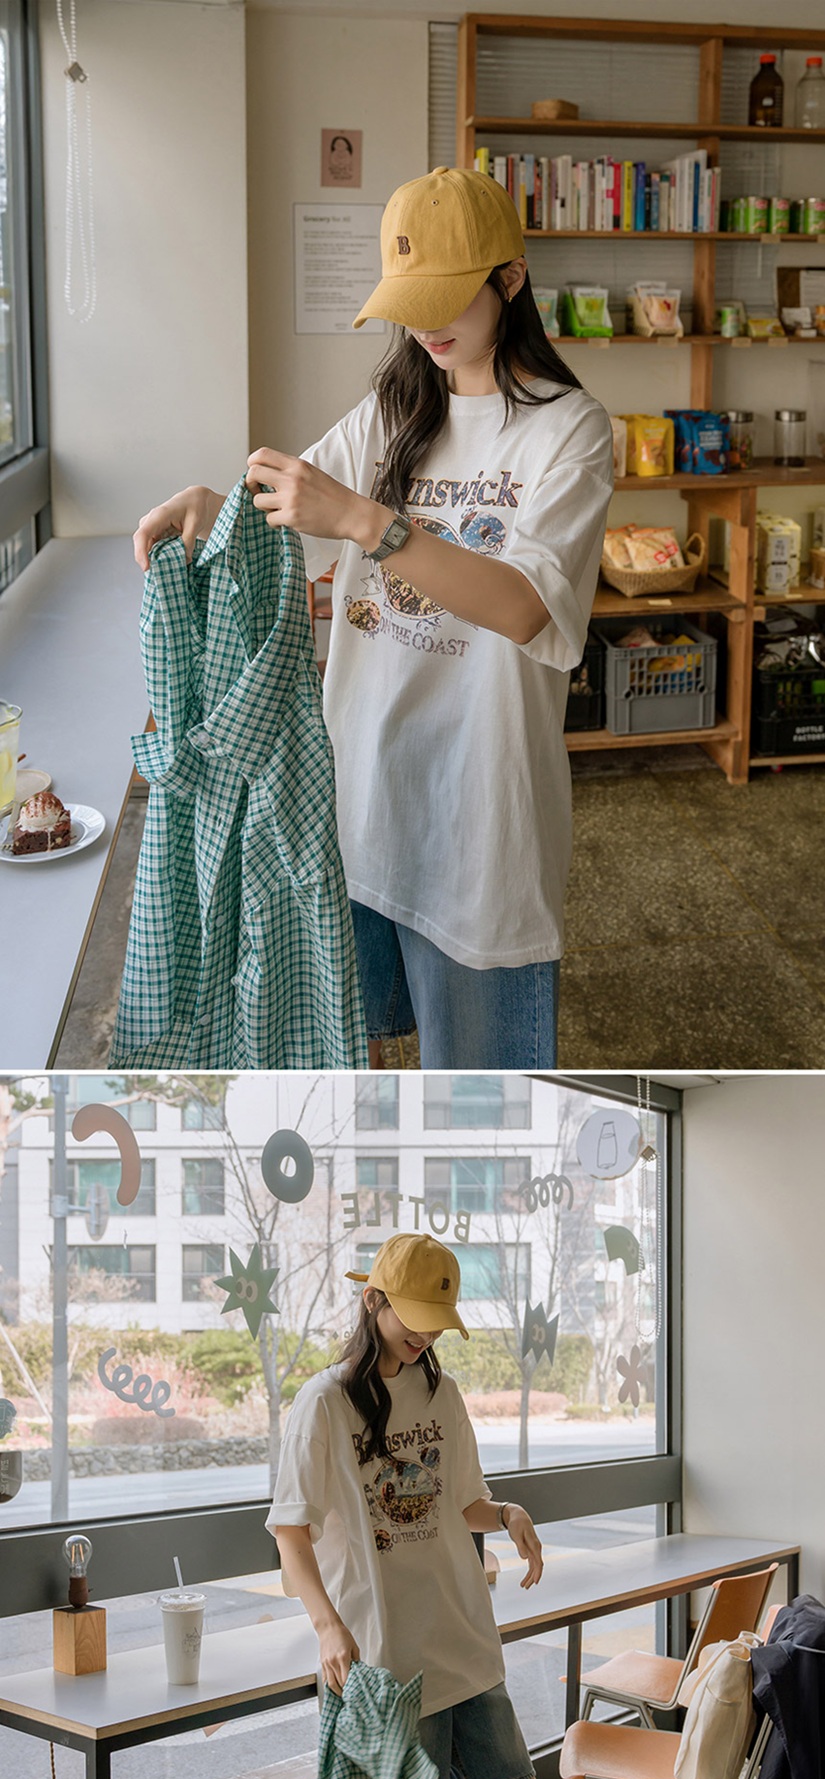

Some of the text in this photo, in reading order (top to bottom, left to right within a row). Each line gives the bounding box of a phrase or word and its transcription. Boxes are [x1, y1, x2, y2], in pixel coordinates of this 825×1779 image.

[397, 236, 410, 255] B
[412, 632, 470, 657] COAST
[441, 1277, 450, 1291] B
